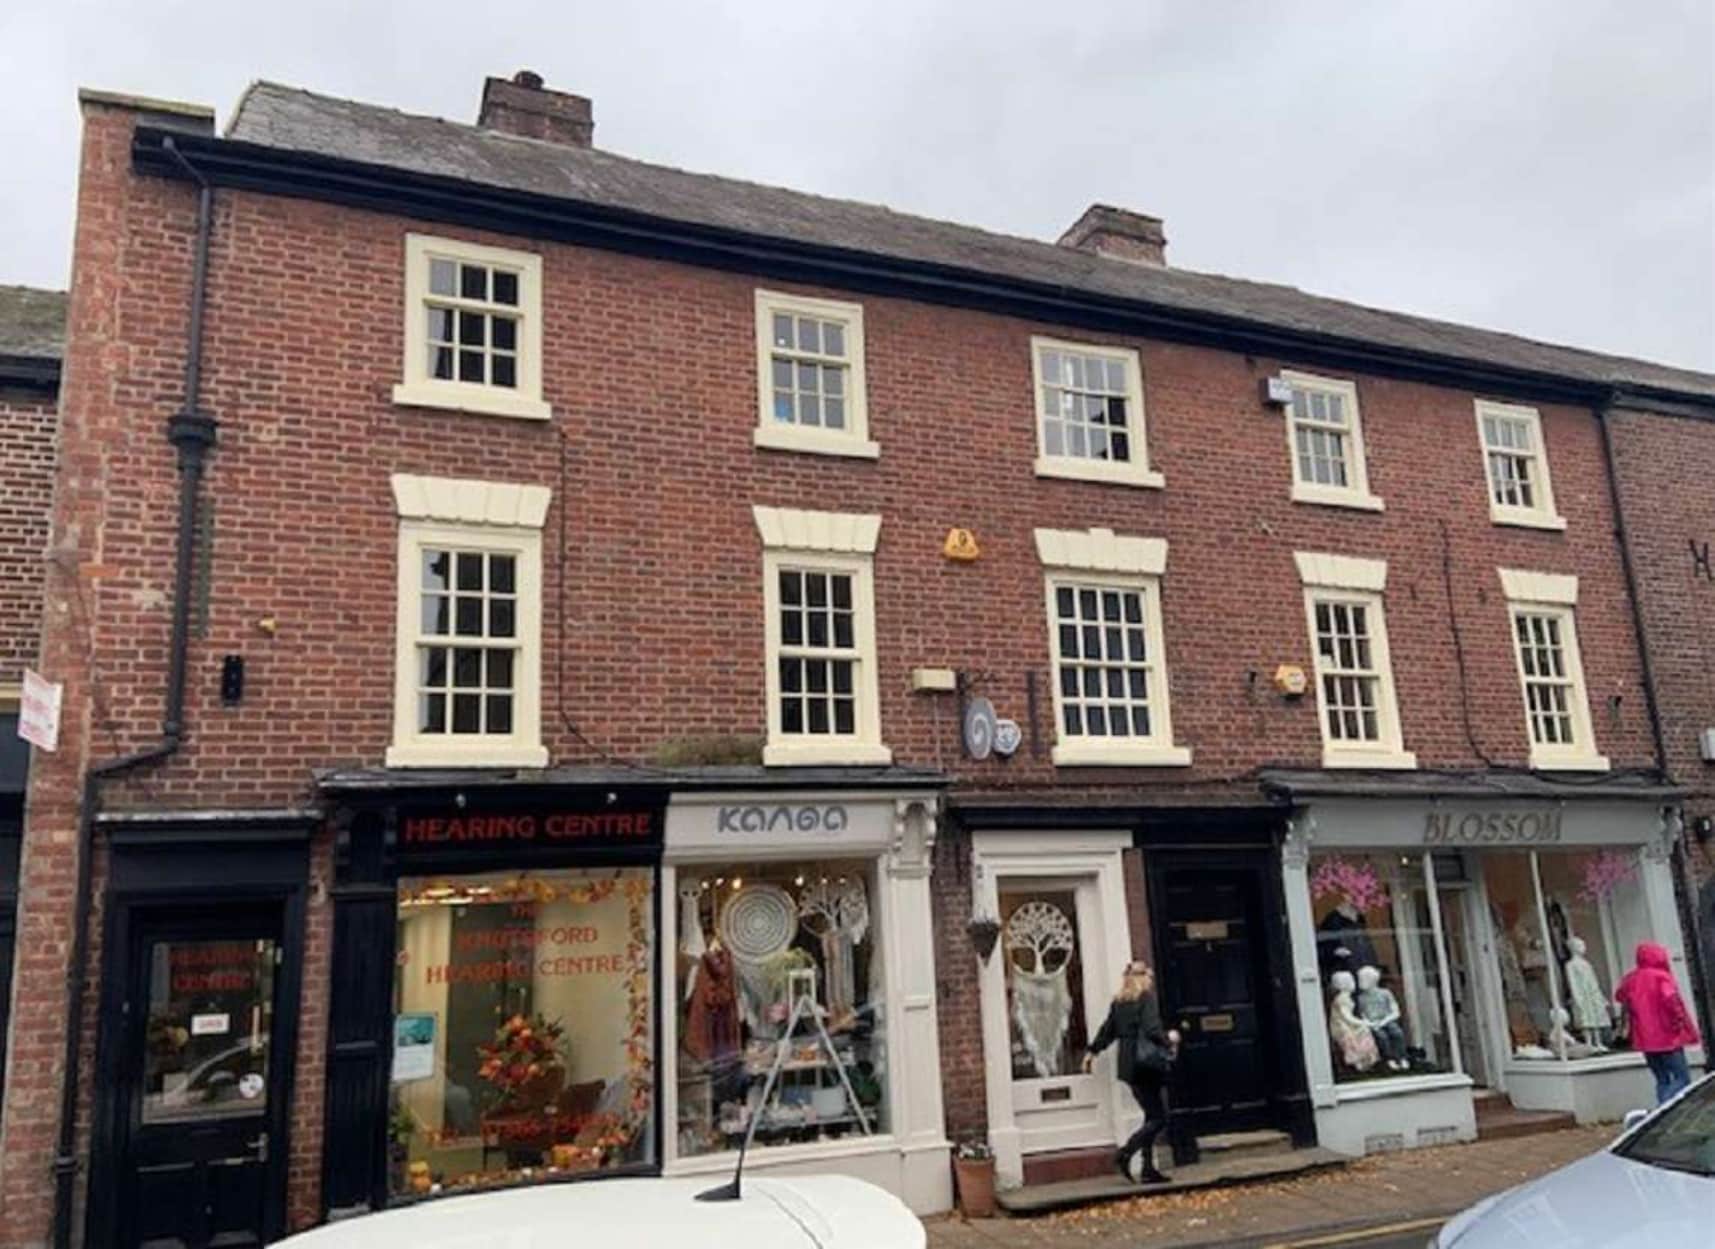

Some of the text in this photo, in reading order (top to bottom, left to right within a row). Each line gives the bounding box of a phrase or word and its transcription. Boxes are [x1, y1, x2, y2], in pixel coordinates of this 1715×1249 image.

[405, 813, 650, 842] HEARING CENTRE
[1423, 808, 1562, 842] BLOSSOM
[538, 954, 624, 976] CENTRE
